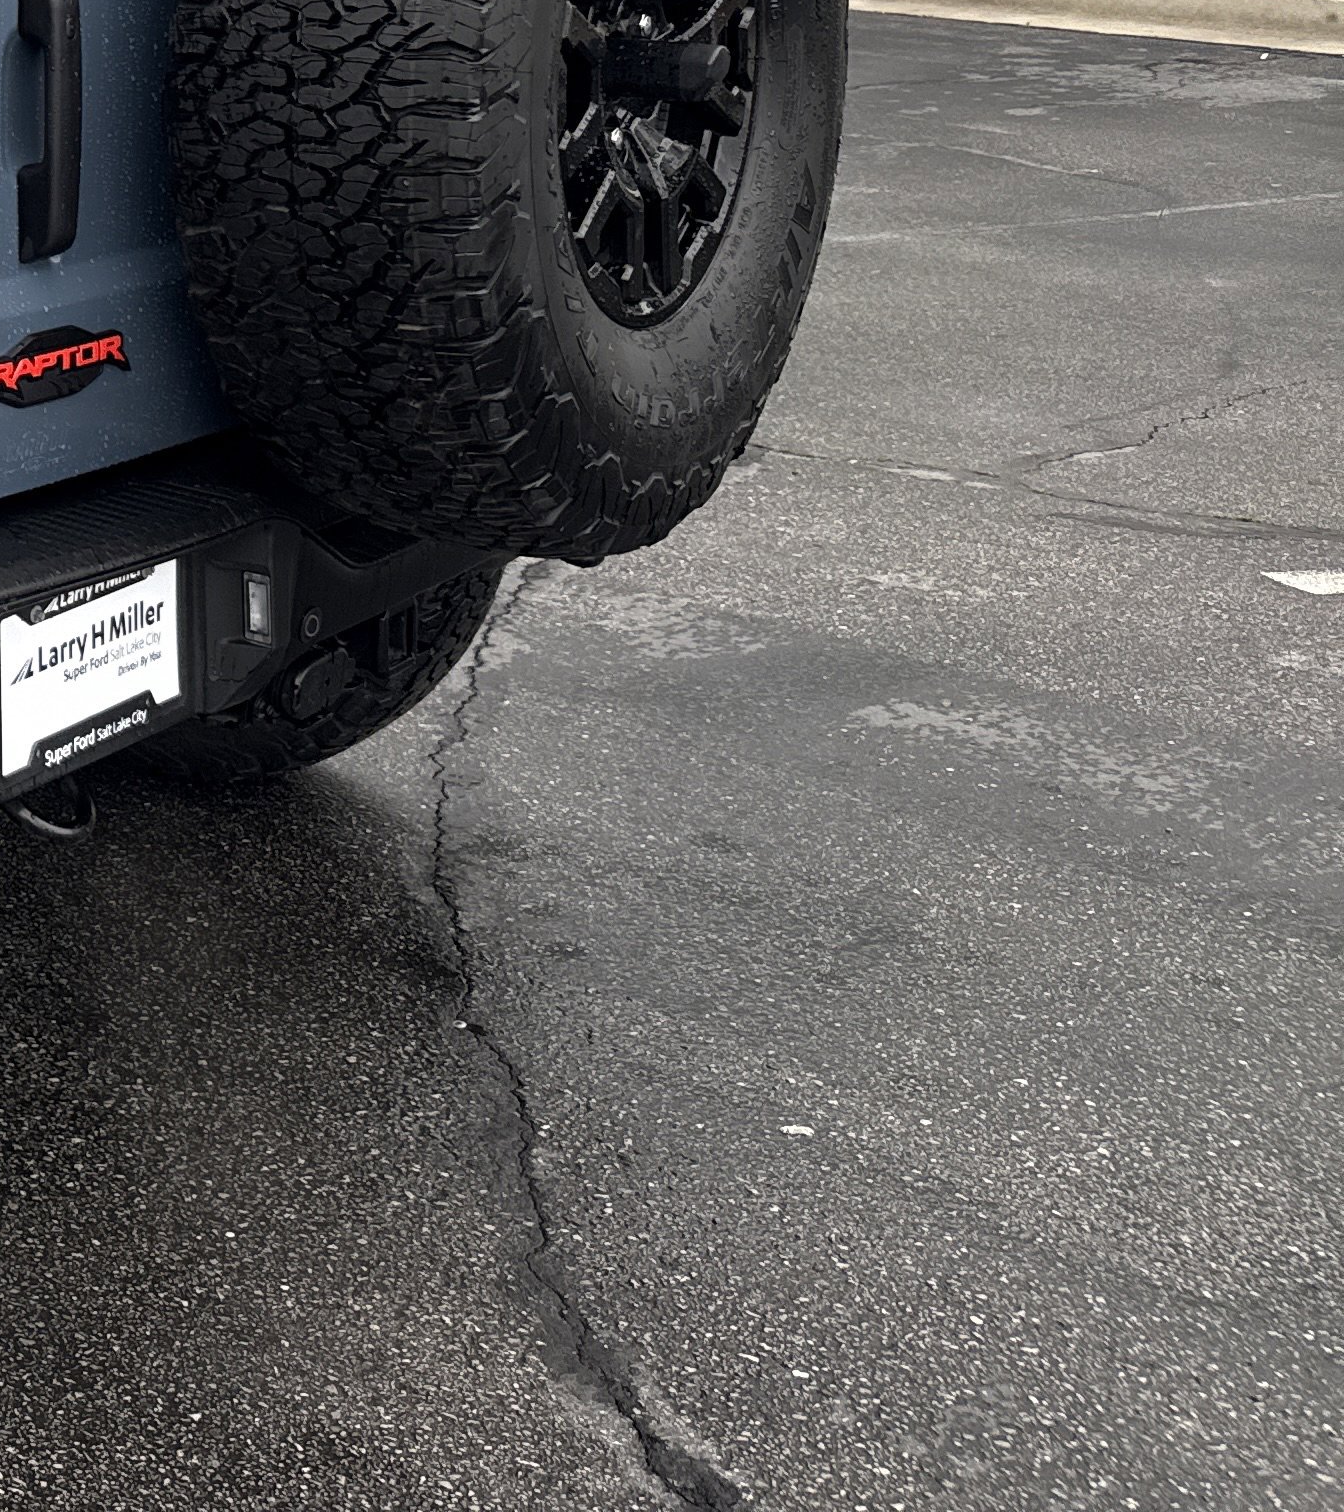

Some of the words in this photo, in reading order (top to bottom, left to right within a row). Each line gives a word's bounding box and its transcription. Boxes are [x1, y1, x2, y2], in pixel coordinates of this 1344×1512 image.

[59, 586, 93, 608] Larry
[38, 633, 88, 673] Larry
[91, 620, 105, 650] H
[109, 600, 164, 643] Miller
[63, 663, 88, 683] Super
[89, 651, 109, 671] Ford
[110, 645, 125, 663] Salt
[126, 637, 145, 656] Lake
[145, 631, 162, 646] City
[44, 741, 73, 768] Super
[73, 727, 96, 753] Ford
[96, 724, 113, 742] Salt
[112, 716, 132, 734] Lake
[131, 708, 148, 725] City
